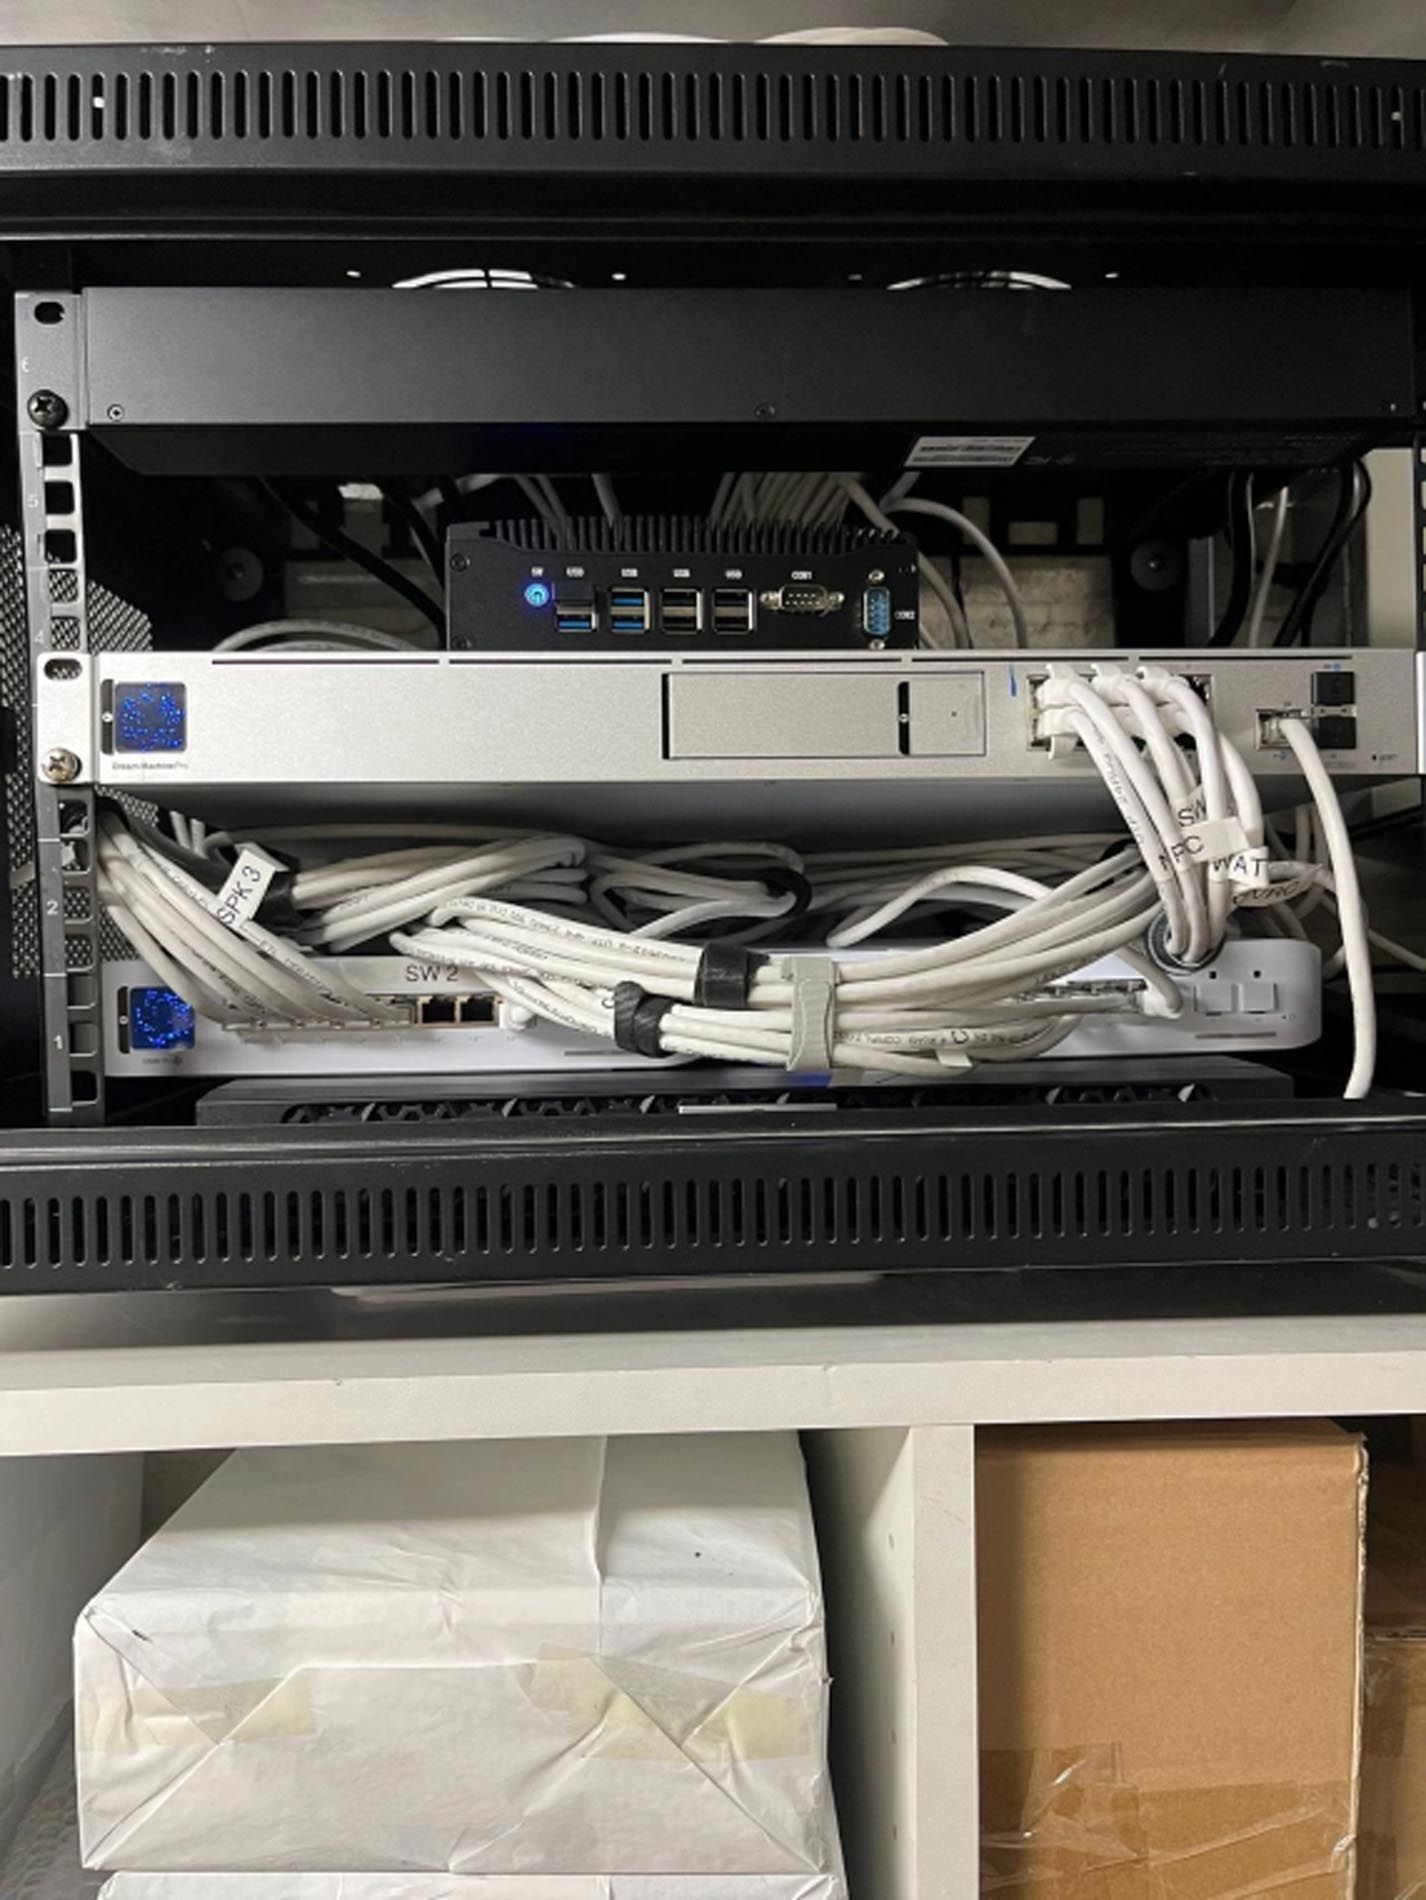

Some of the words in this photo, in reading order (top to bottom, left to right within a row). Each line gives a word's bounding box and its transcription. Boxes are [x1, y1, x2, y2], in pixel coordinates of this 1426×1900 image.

[27, 493, 38, 509] 5
[1170, 835, 1205, 862] PC
[216, 880, 254, 925] SPK
[241, 865, 261, 882] 3
[46, 900, 58, 915] 2
[405, 965, 440, 983] SW
[441, 965, 459, 983] 2
[53, 1034, 63, 1049] 1
